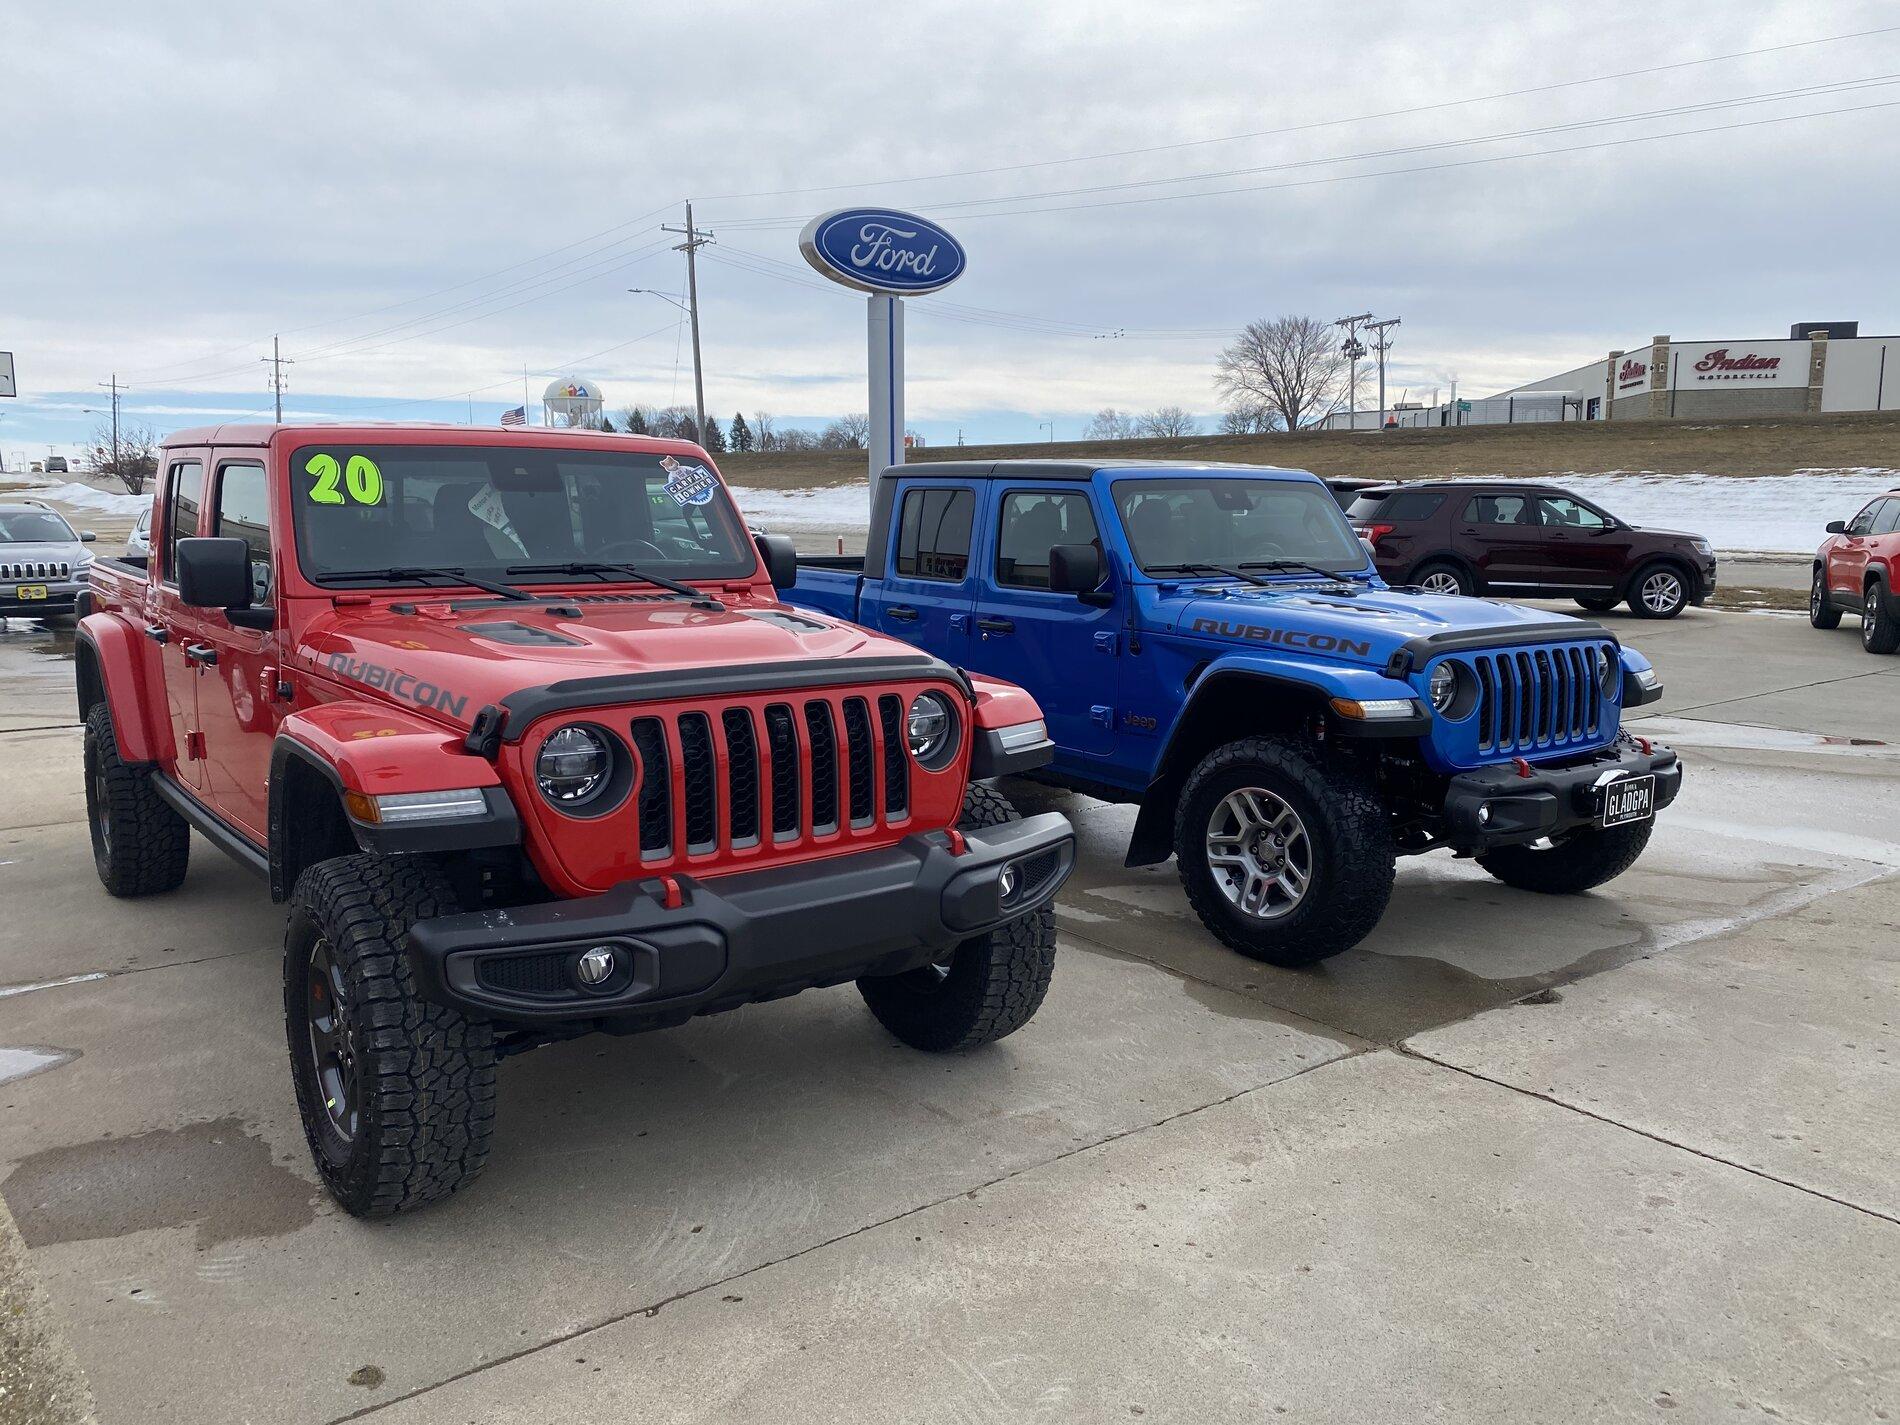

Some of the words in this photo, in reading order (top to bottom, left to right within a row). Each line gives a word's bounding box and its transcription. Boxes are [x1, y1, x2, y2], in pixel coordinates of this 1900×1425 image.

[851, 223, 938, 276] Ford
[1695, 349, 1781, 371] Indian
[1698, 373, 1777, 381] MOTORCYCLE
[305, 453, 384, 506] 20
[669, 471, 708, 493] CARFAX
[1192, 618, 1371, 657] RUBICON
[327, 652, 468, 717] RUBICON
[1609, 788, 1649, 816] GLADGPA
